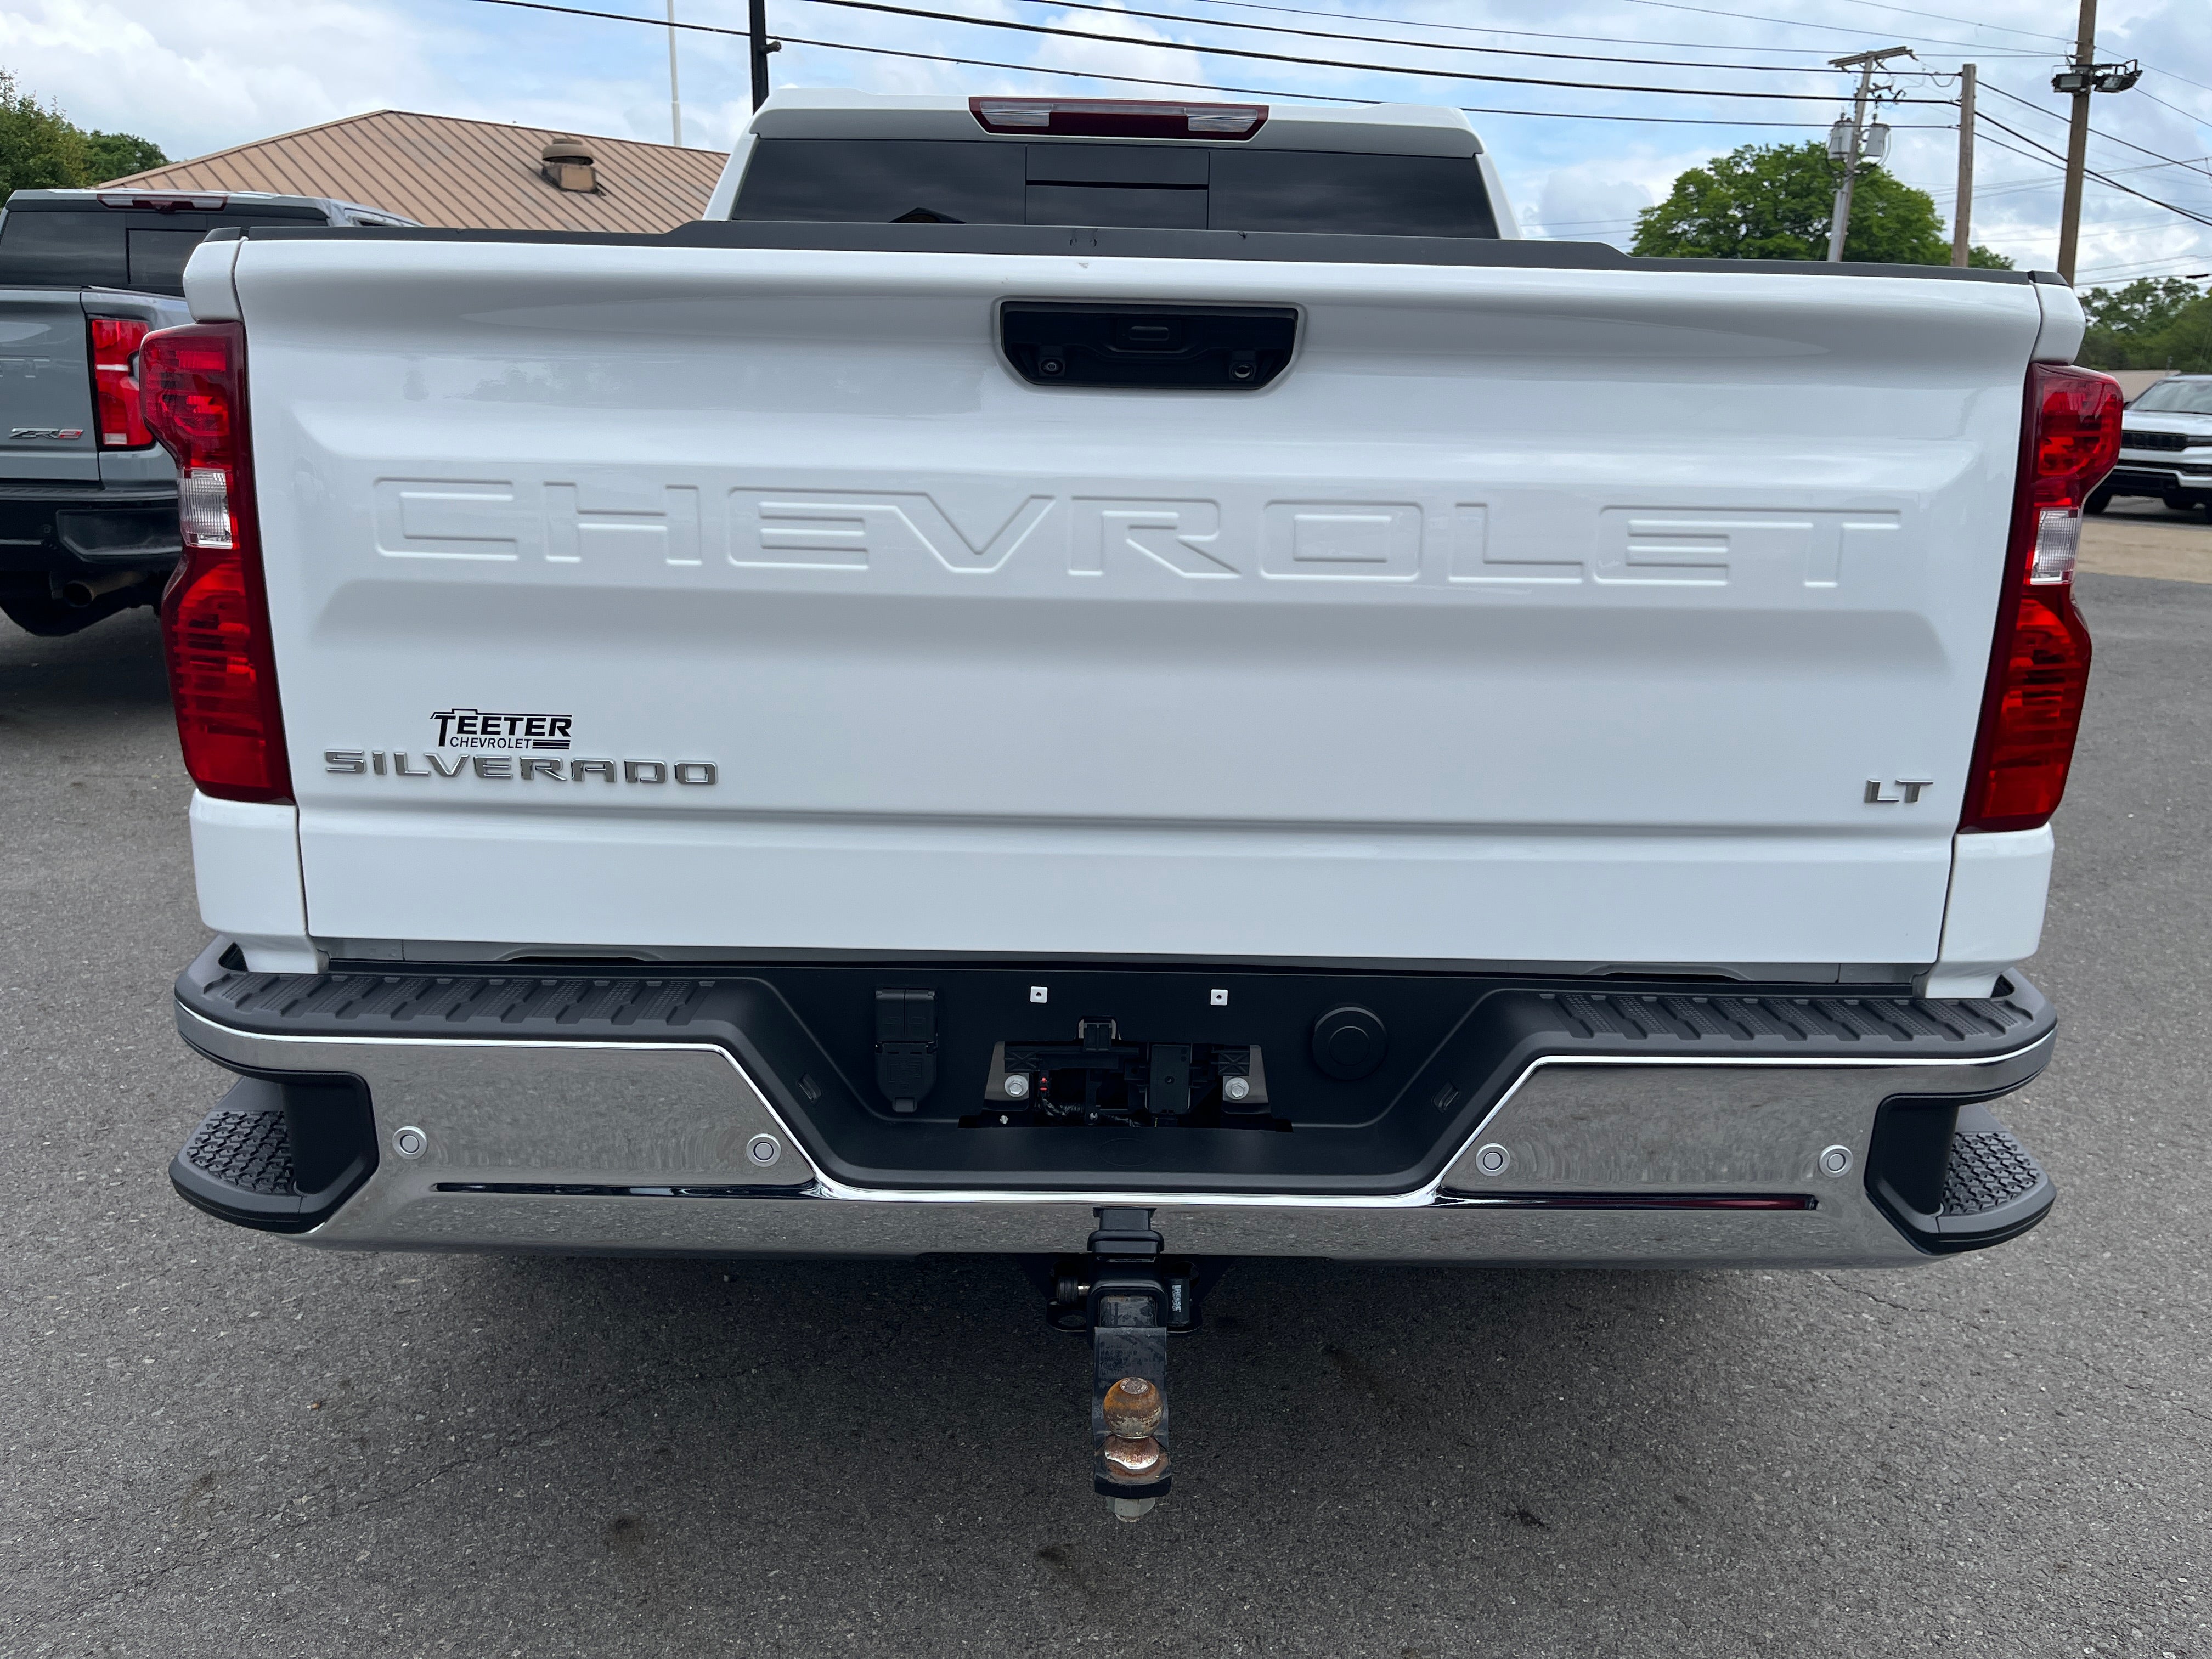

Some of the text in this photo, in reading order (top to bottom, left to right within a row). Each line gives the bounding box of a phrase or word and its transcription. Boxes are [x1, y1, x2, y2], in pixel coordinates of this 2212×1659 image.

[373, 476, 1901, 590] CHEVROLET
[431, 712, 572, 746] TEETER
[450, 737, 532, 749] CHEVROLET
[325, 749, 718, 785] SILVERADO
[1864, 780, 1934, 803] LT
